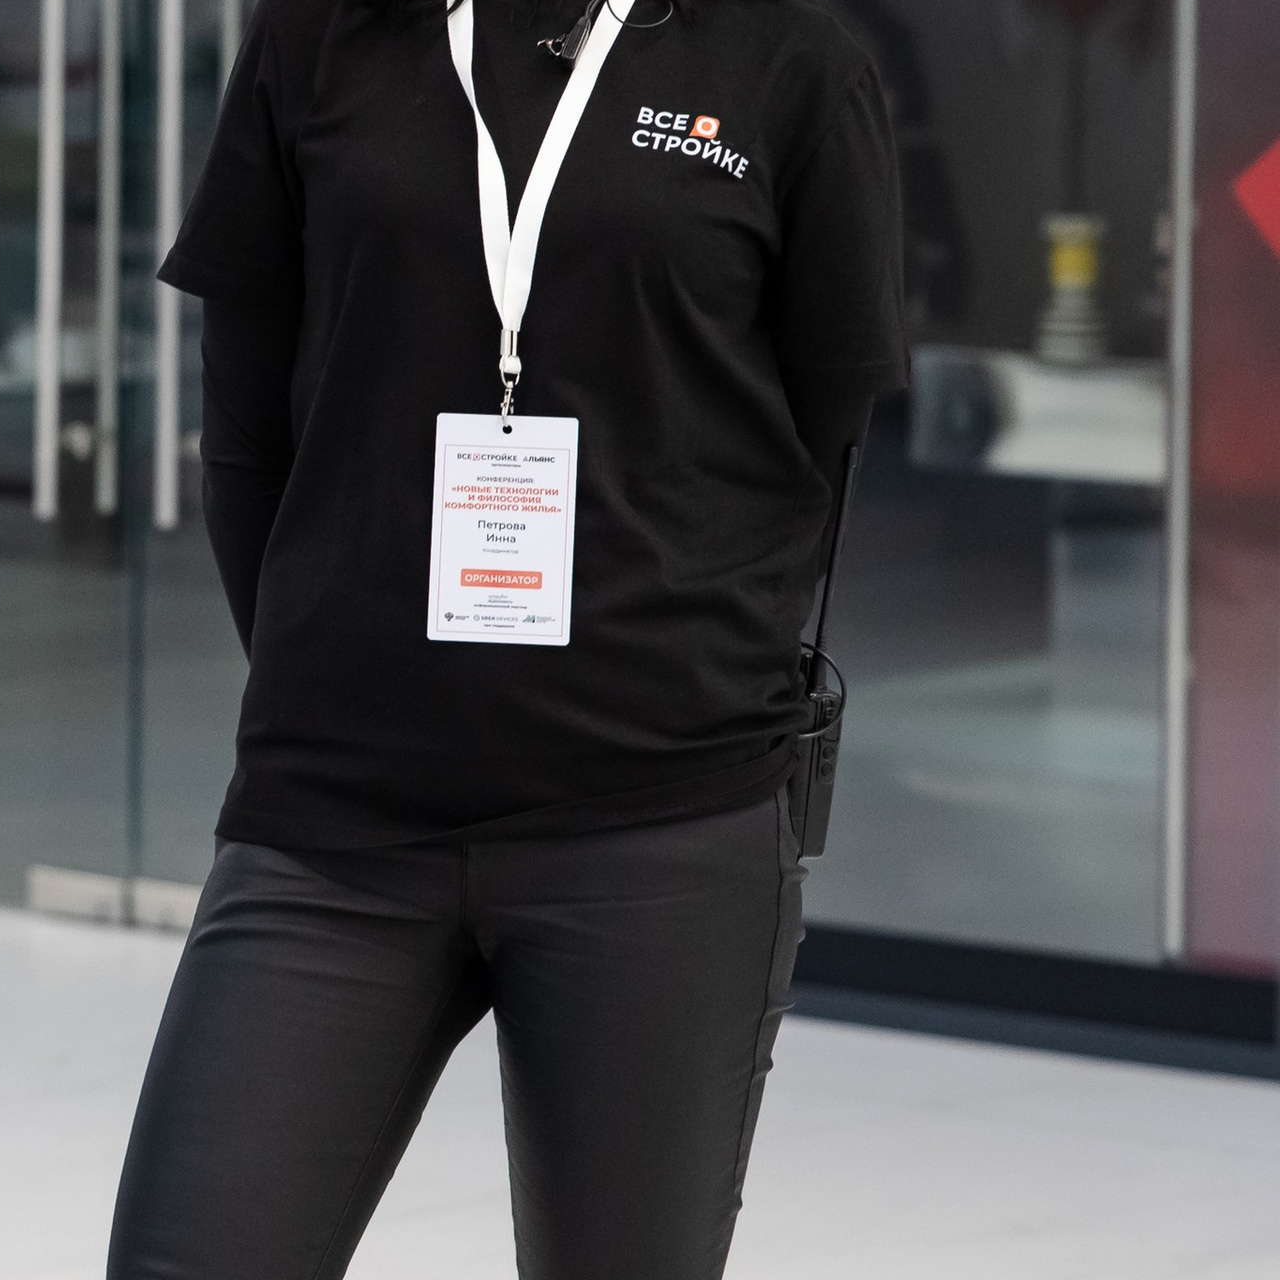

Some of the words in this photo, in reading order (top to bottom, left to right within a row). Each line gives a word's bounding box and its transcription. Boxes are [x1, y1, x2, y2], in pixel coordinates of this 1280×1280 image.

[636, 106, 690, 131] ВСЕ
[631, 129, 749, 179] СТРОЙКЕ
[481, 453, 518, 462] СТРОЙКЕ
[476, 476, 535, 485] КОНФЕРЕНЦИЯ:
[451, 485, 492, 494] «НОВЫЕ
[493, 486, 559, 496] ТЕХНОЛОГИИ
[477, 494, 542, 504] ФИЛОСОФИЯ
[444, 502, 519, 512] КОМФОРТНОГО
[521, 504, 562, 513] ЖИЛЬЯ»
[477, 519, 526, 531] Петрова
[486, 533, 516, 543] Инна
[464, 573, 539, 585] ОРГАНИЗАТОР
